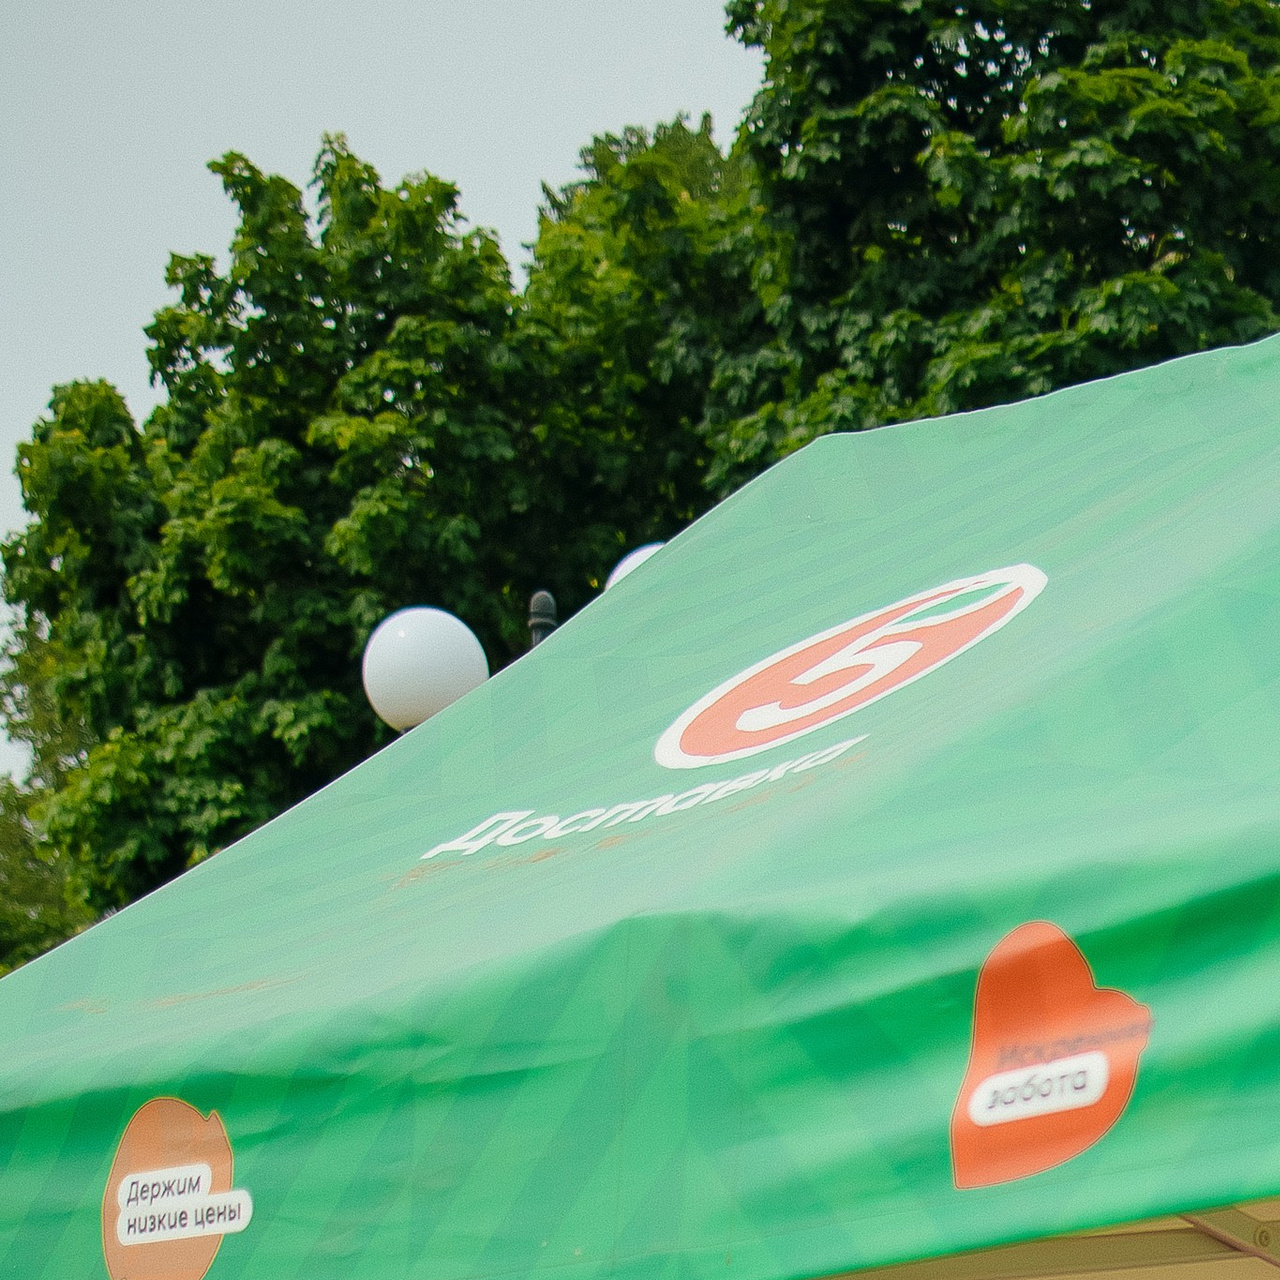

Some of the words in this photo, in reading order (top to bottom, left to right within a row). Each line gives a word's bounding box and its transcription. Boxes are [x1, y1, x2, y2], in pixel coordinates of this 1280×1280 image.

[420, 733, 870, 860] Доставка
[987, 1070, 1088, 1110] забота
[126, 1174, 202, 1207] Держим
[126, 1209, 189, 1236] низкие
[194, 1202, 242, 1229] цены
